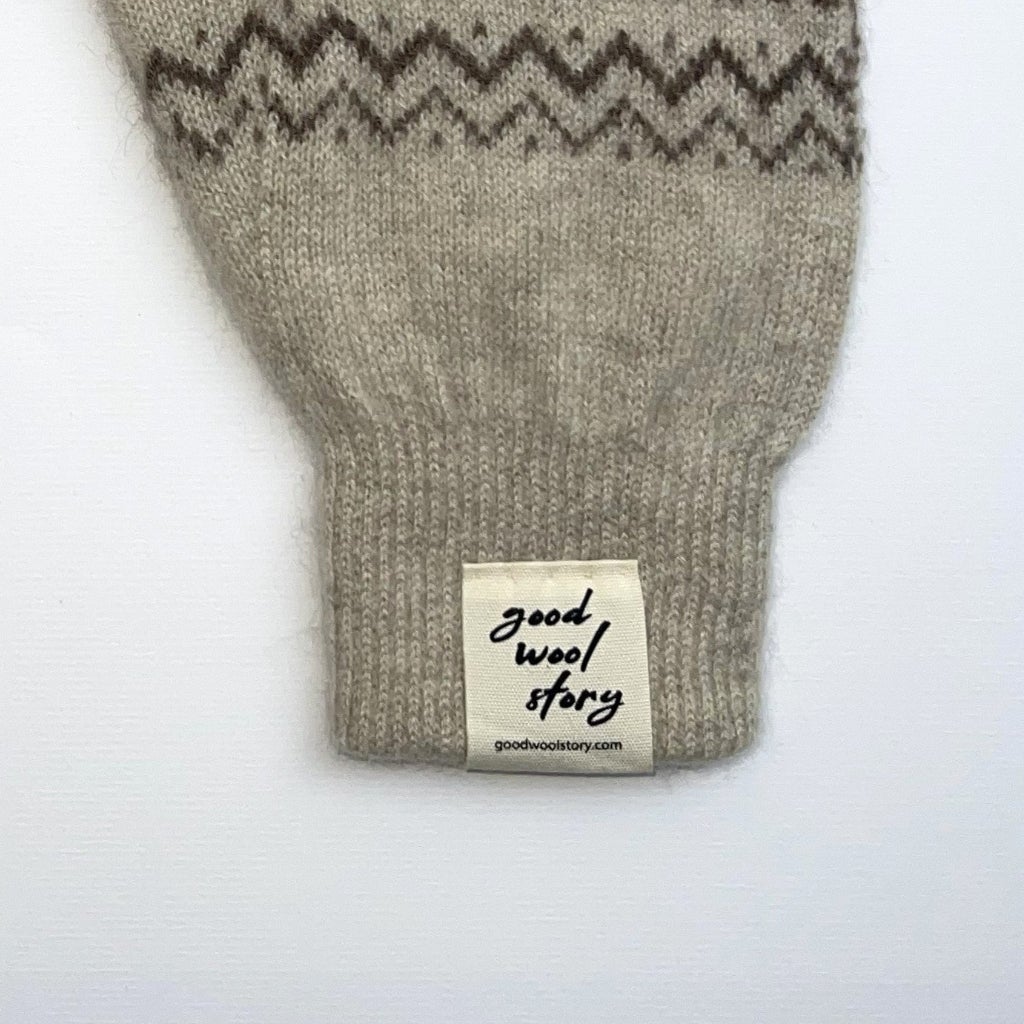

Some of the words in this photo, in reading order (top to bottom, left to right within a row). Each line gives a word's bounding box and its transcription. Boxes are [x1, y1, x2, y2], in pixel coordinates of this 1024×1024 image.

[489, 587, 594, 643] good
[514, 620, 612, 673] wool
[525, 669, 625, 727] story
[494, 738, 623, 754] goodwoolstory.com
